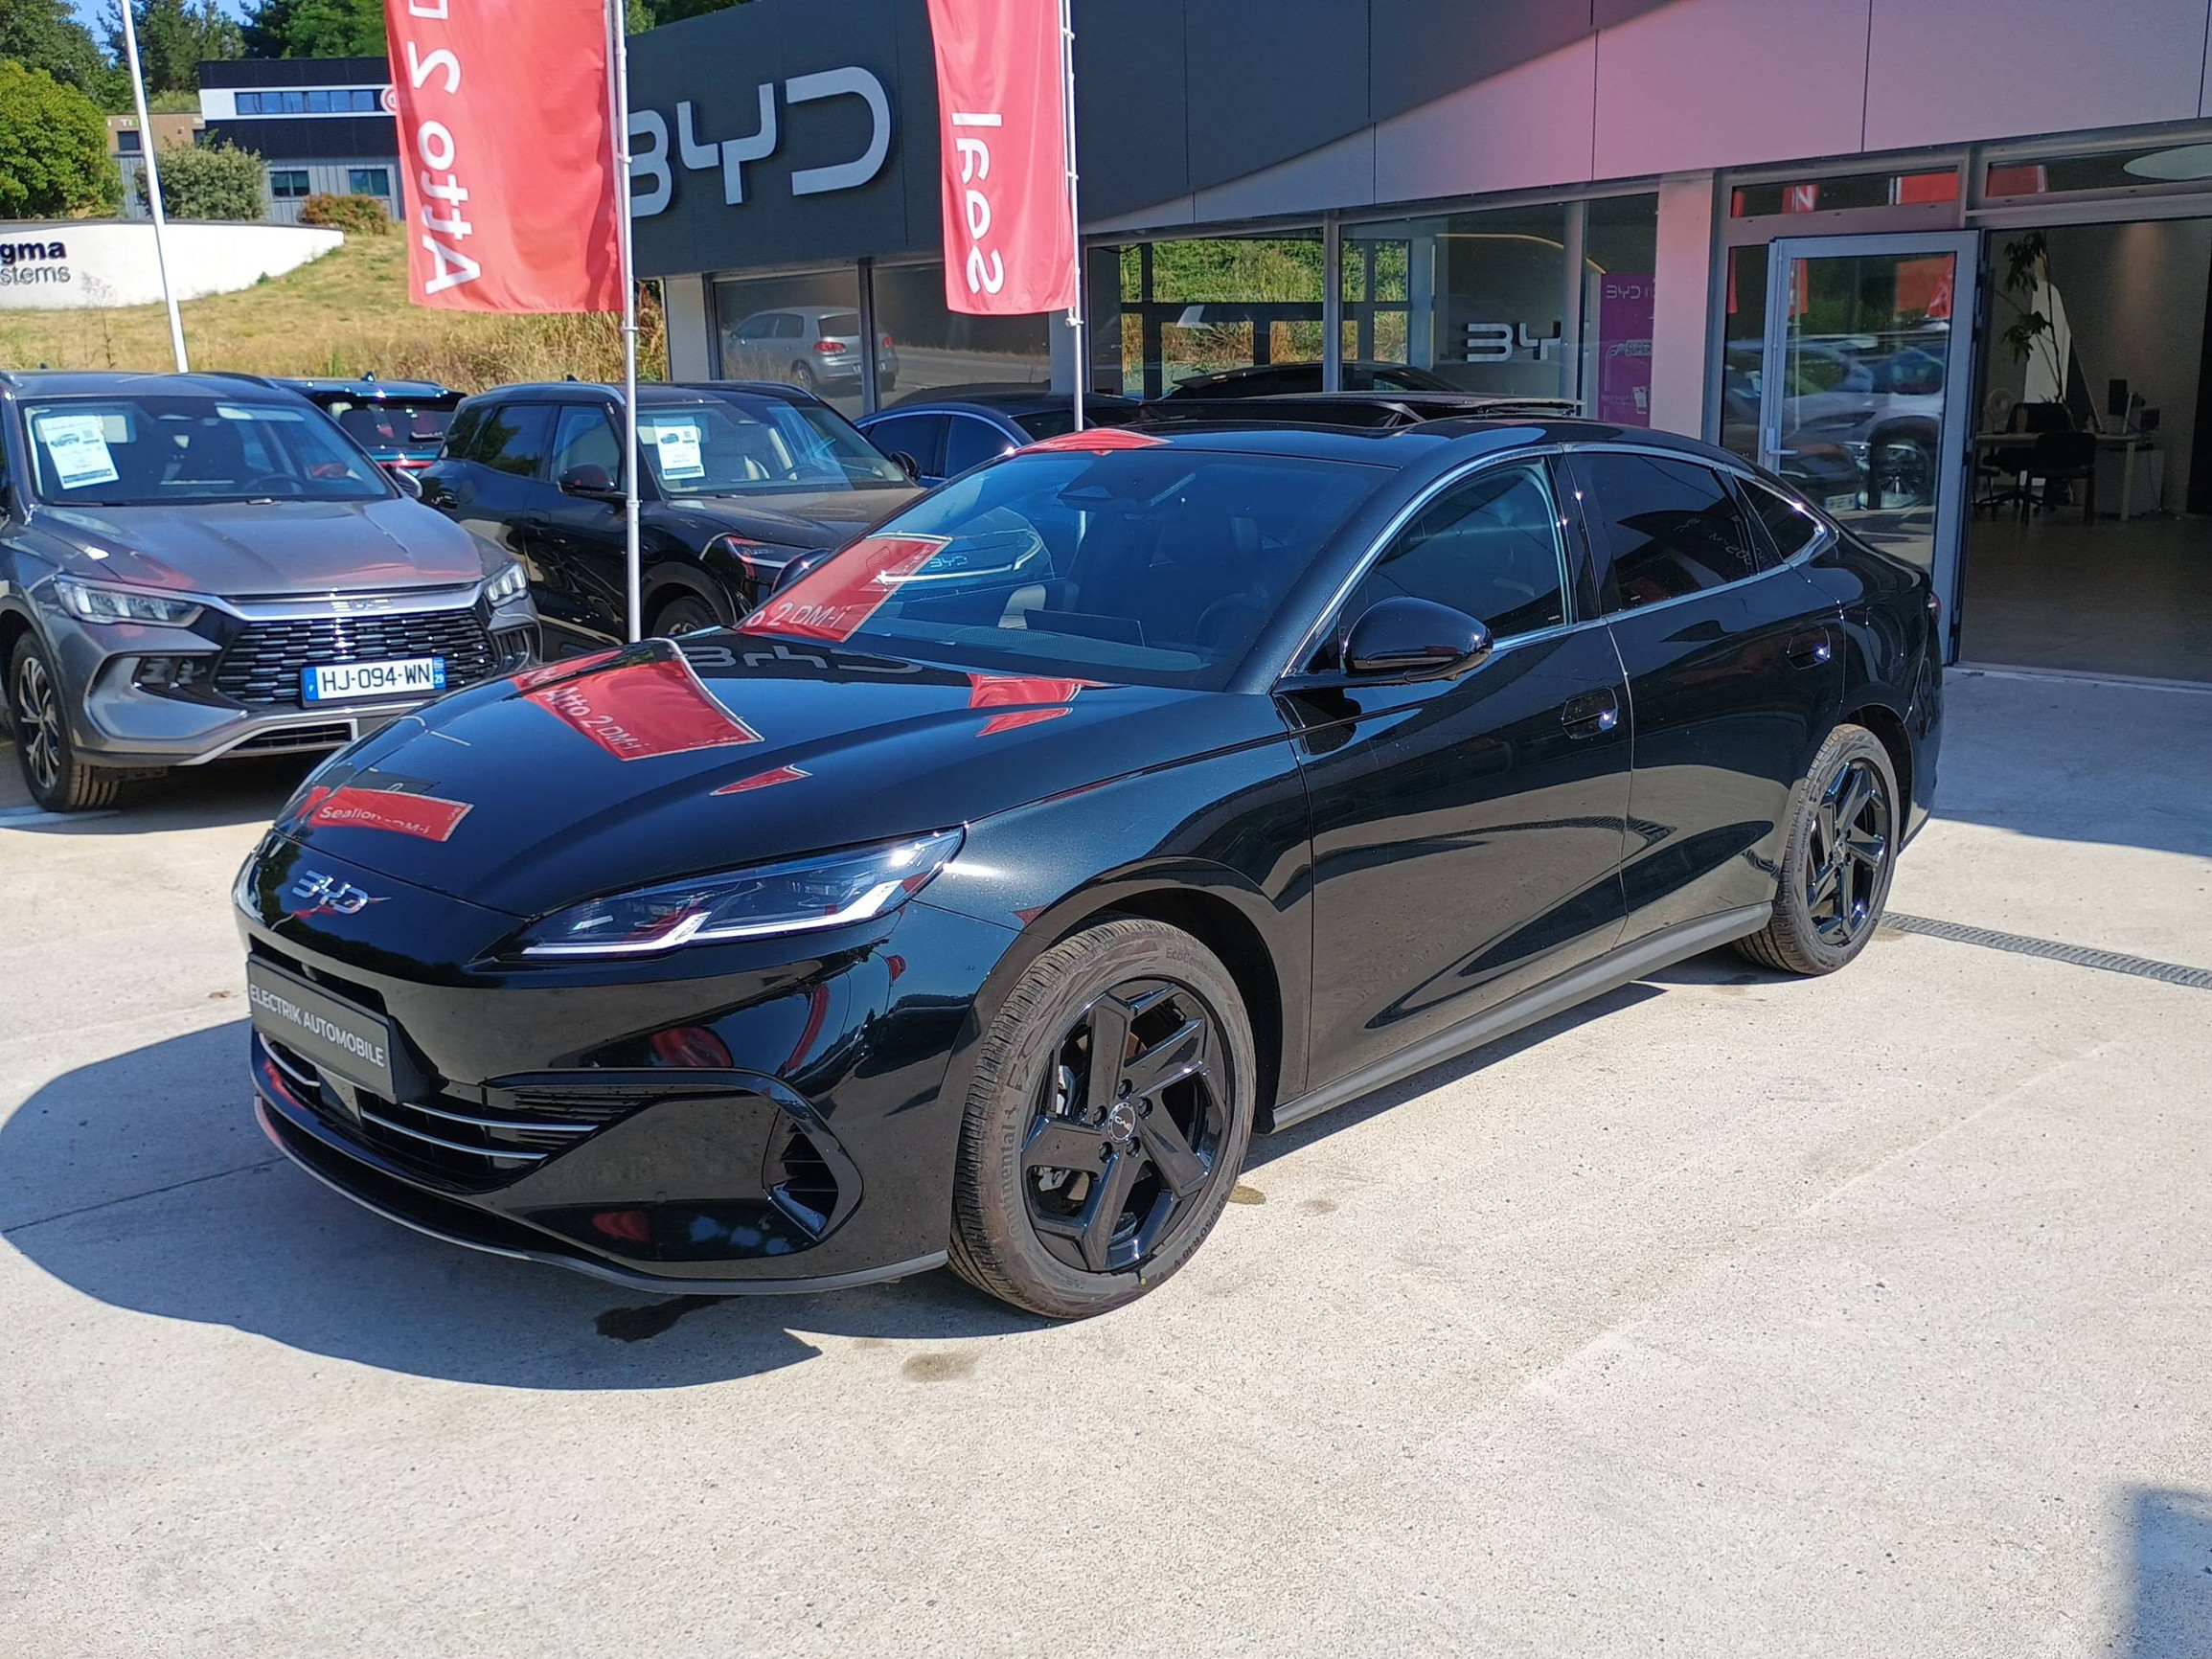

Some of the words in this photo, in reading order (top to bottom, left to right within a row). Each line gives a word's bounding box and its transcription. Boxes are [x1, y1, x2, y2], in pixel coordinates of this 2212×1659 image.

[1606, 284, 1641, 299] BYD
[1467, 322, 1561, 362] BY
[322, 663, 431, 693] HJ-094-WN
[579, 715, 614, 728] 2
[292, 870, 369, 914] BYD
[249, 984, 302, 1026] ELECTRIK
[303, 1013, 385, 1068] AUTOMOBILE
